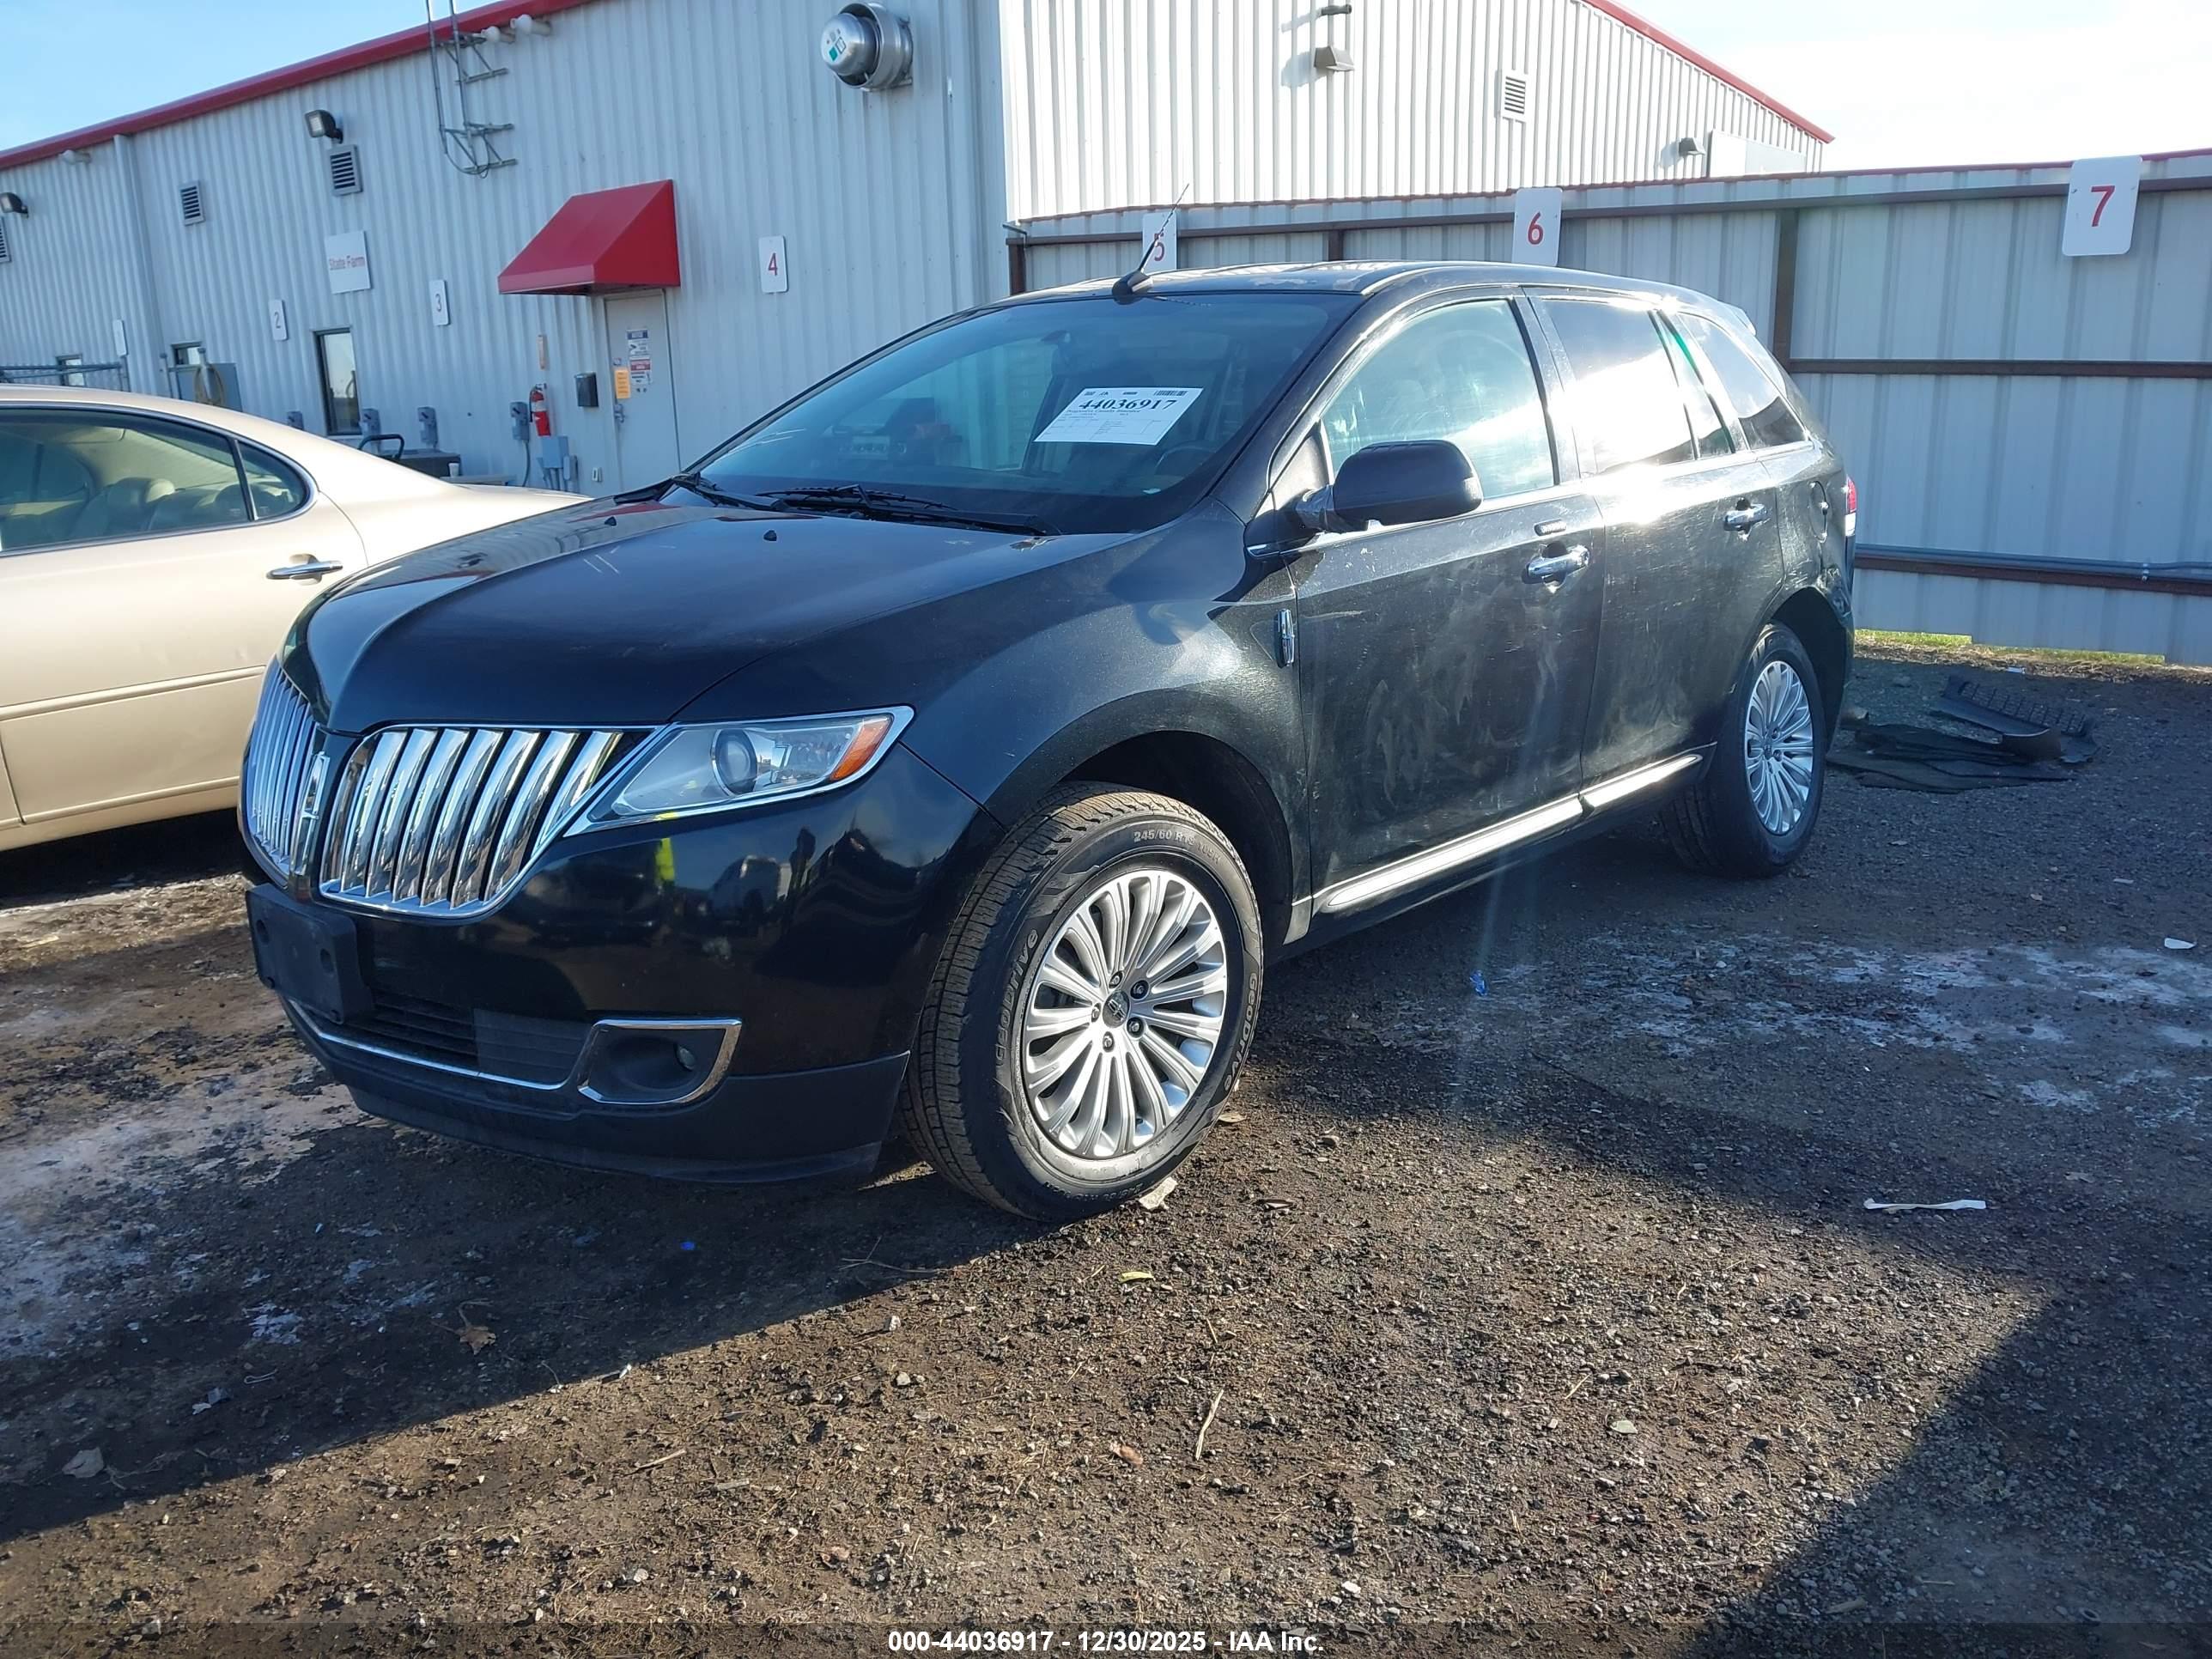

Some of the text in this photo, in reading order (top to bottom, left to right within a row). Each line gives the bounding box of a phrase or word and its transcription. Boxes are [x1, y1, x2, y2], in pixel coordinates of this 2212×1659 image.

[2090, 185, 2116, 228] 7
[1528, 211, 1544, 246] 6
[1154, 232, 1165, 262] 5
[768, 252, 778, 276] 4
[435, 293, 442, 313] 3
[274, 311, 282, 329] 2
[1079, 398, 1177, 410] 44036917
[1133, 830, 1171, 842] 245/60
